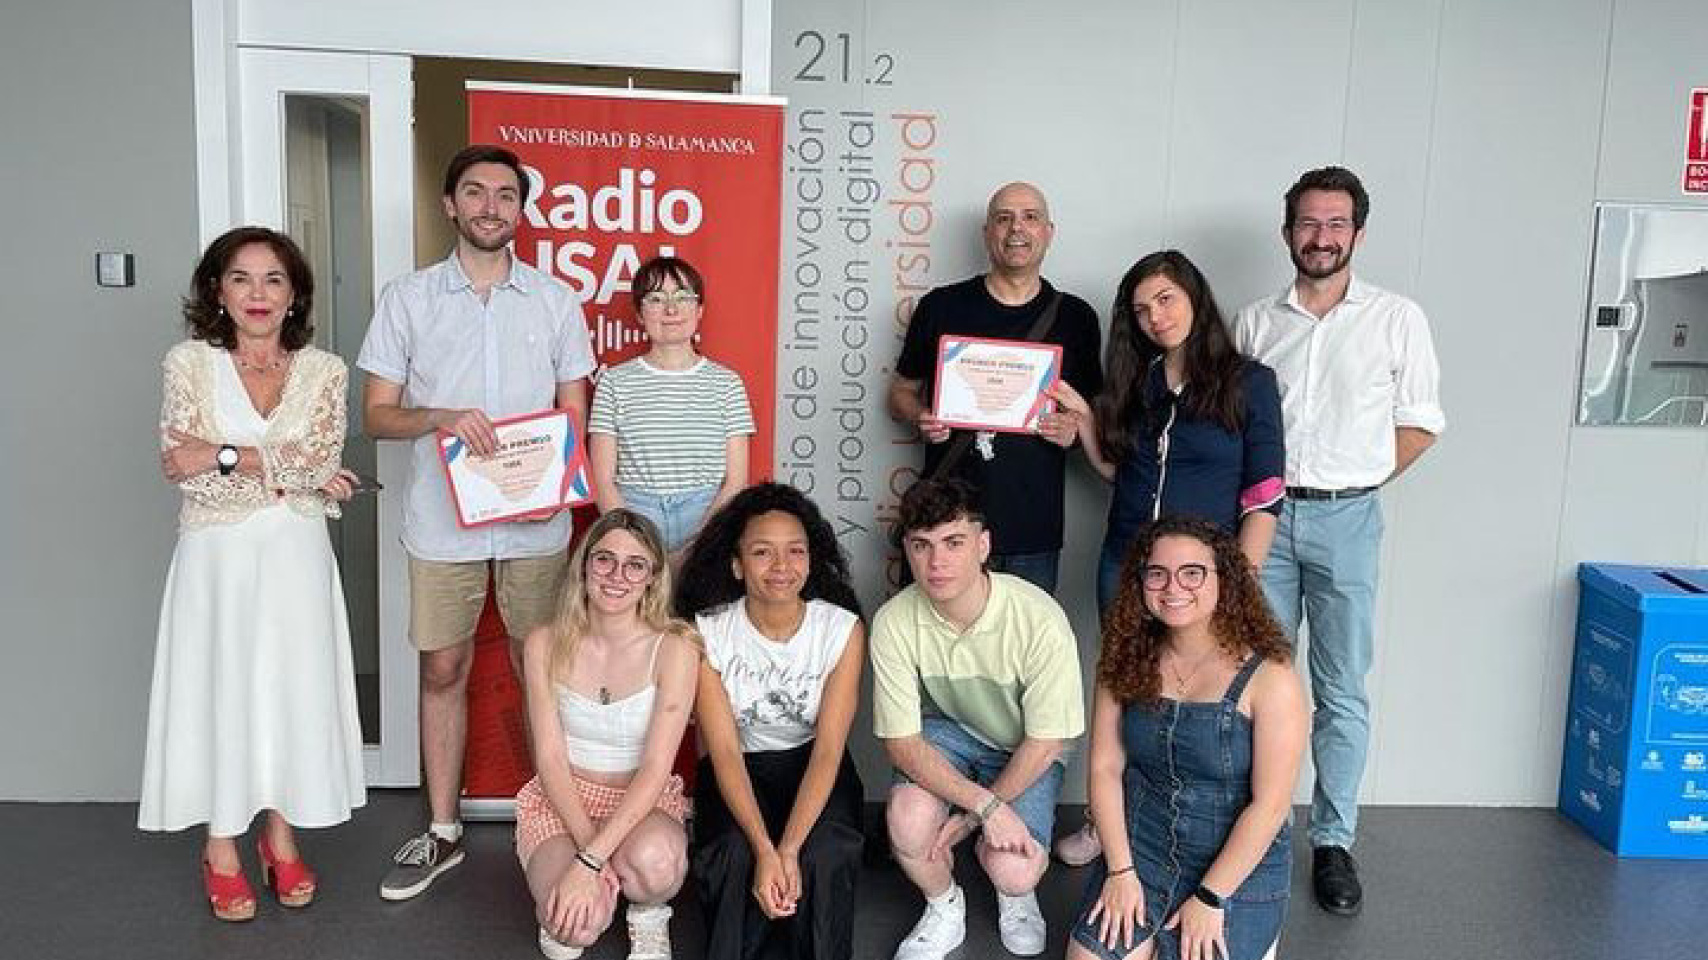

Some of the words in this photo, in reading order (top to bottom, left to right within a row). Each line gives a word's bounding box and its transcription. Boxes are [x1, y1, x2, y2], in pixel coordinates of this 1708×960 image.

[646, 133, 755, 154] SALAMANCA
[837, 111, 880, 243] digital
[520, 164, 704, 235] Radio
[785, 109, 826, 350] innovación
[783, 365, 818, 420] de
[831, 259, 870, 502] producción
[837, 515, 869, 537] y
